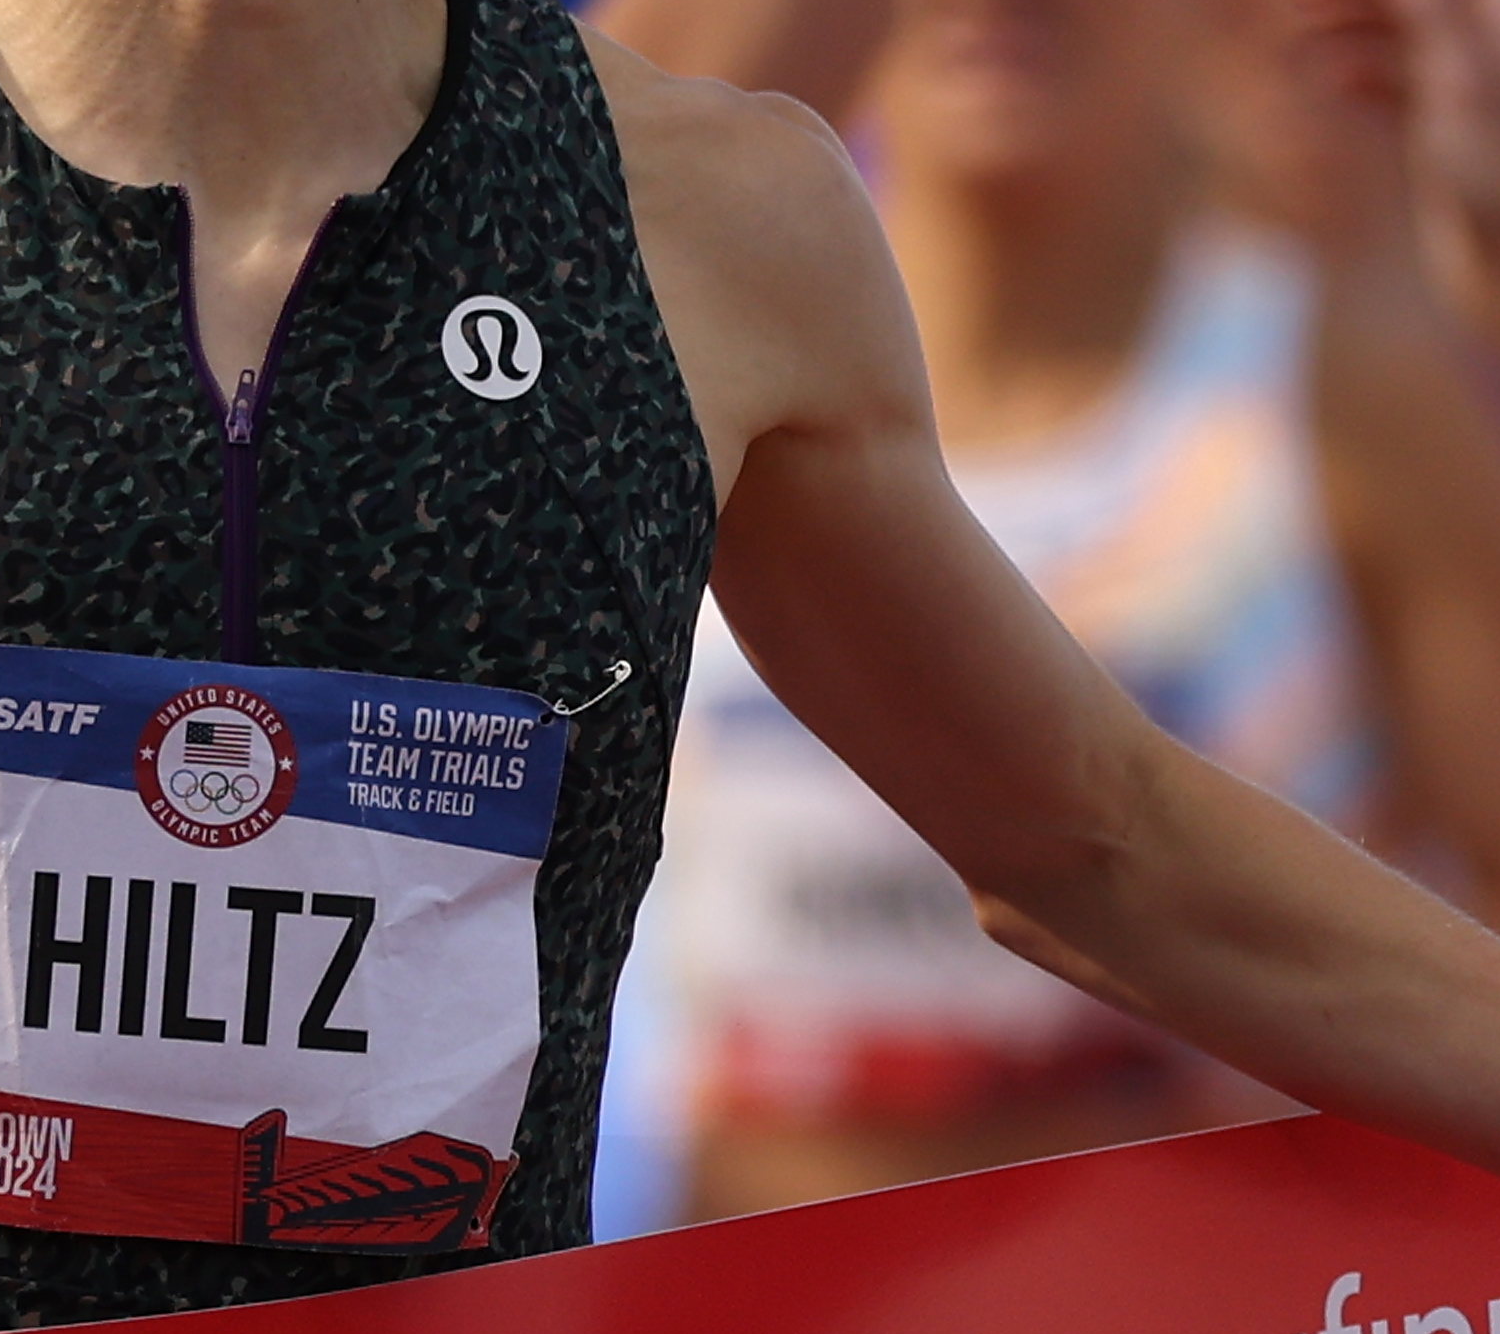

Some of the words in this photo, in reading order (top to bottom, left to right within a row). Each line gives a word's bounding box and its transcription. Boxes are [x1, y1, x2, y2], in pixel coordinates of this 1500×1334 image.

[156, 687, 218, 727] UNITED
[225, 689, 283, 736] STATES
[350, 699, 403, 739] U.S.
[413, 706, 535, 750] OLYMPIC
[347, 740, 422, 780] TEAM
[429, 749, 527, 791] TRIALS
[151, 798, 219, 844] OLYMPIC
[229, 808, 274, 842] TEAM
[346, 781, 405, 810] TRACK
[407, 788, 422, 811] &
[424, 789, 476, 817] FIELD
[21, 870, 378, 1055] HILTZ
